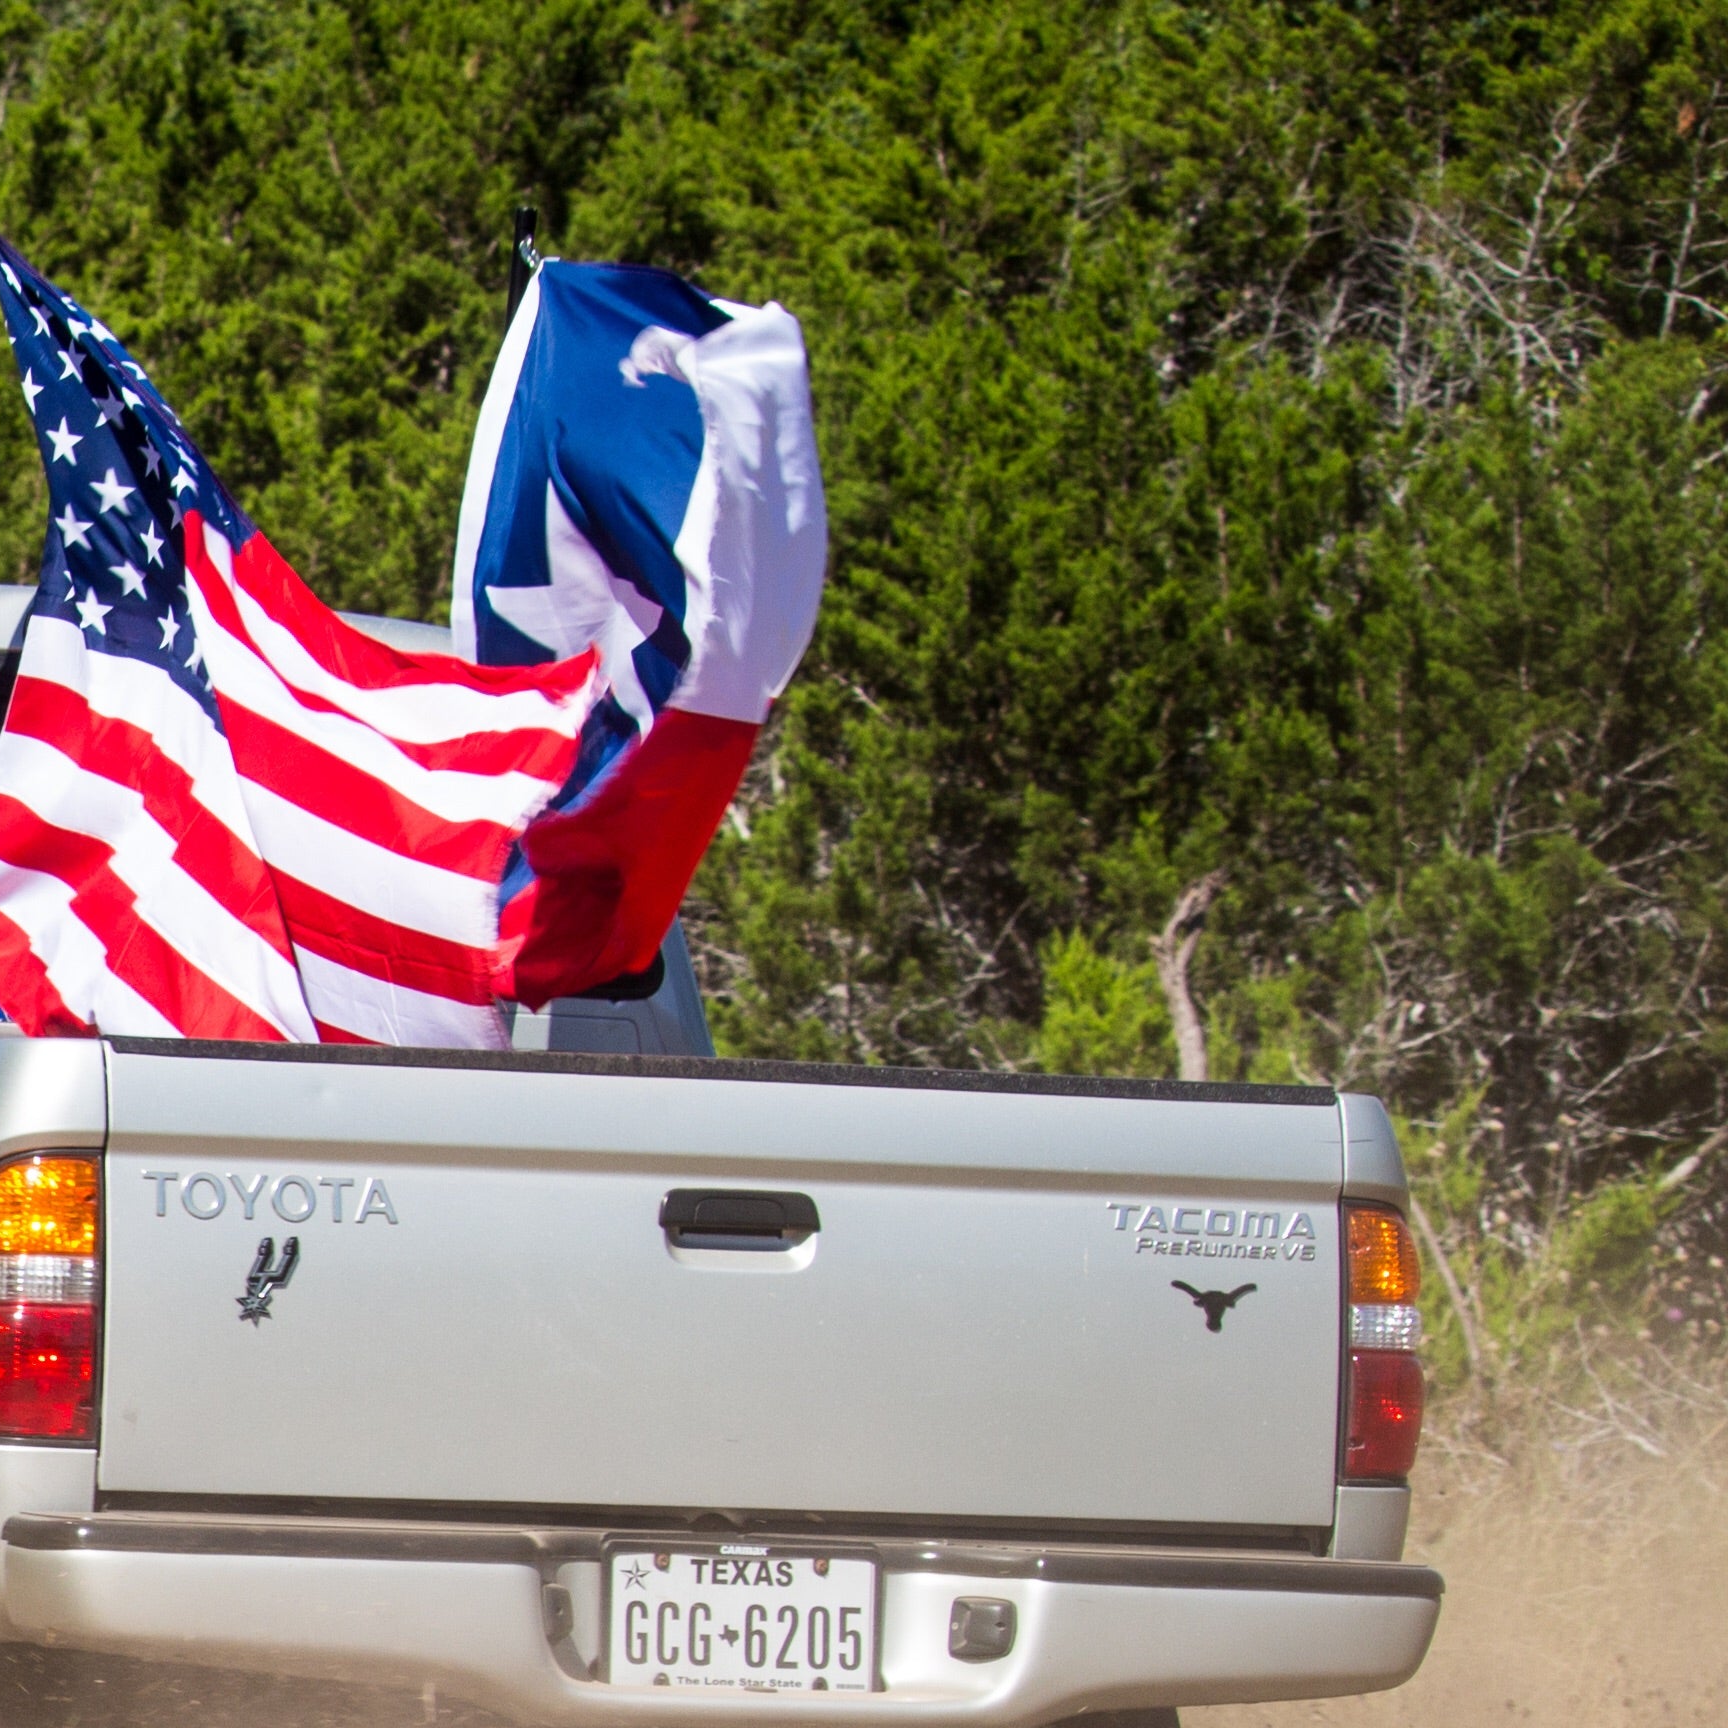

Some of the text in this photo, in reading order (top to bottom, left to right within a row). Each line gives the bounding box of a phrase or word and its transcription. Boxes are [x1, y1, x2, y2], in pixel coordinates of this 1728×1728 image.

[141, 1169, 399, 1225] TOYOTA
[1106, 1201, 1315, 1240] TACOMA
[690, 1559, 793, 1587] TEXAS
[677, 1676, 802, 1688] The Lone Star State
